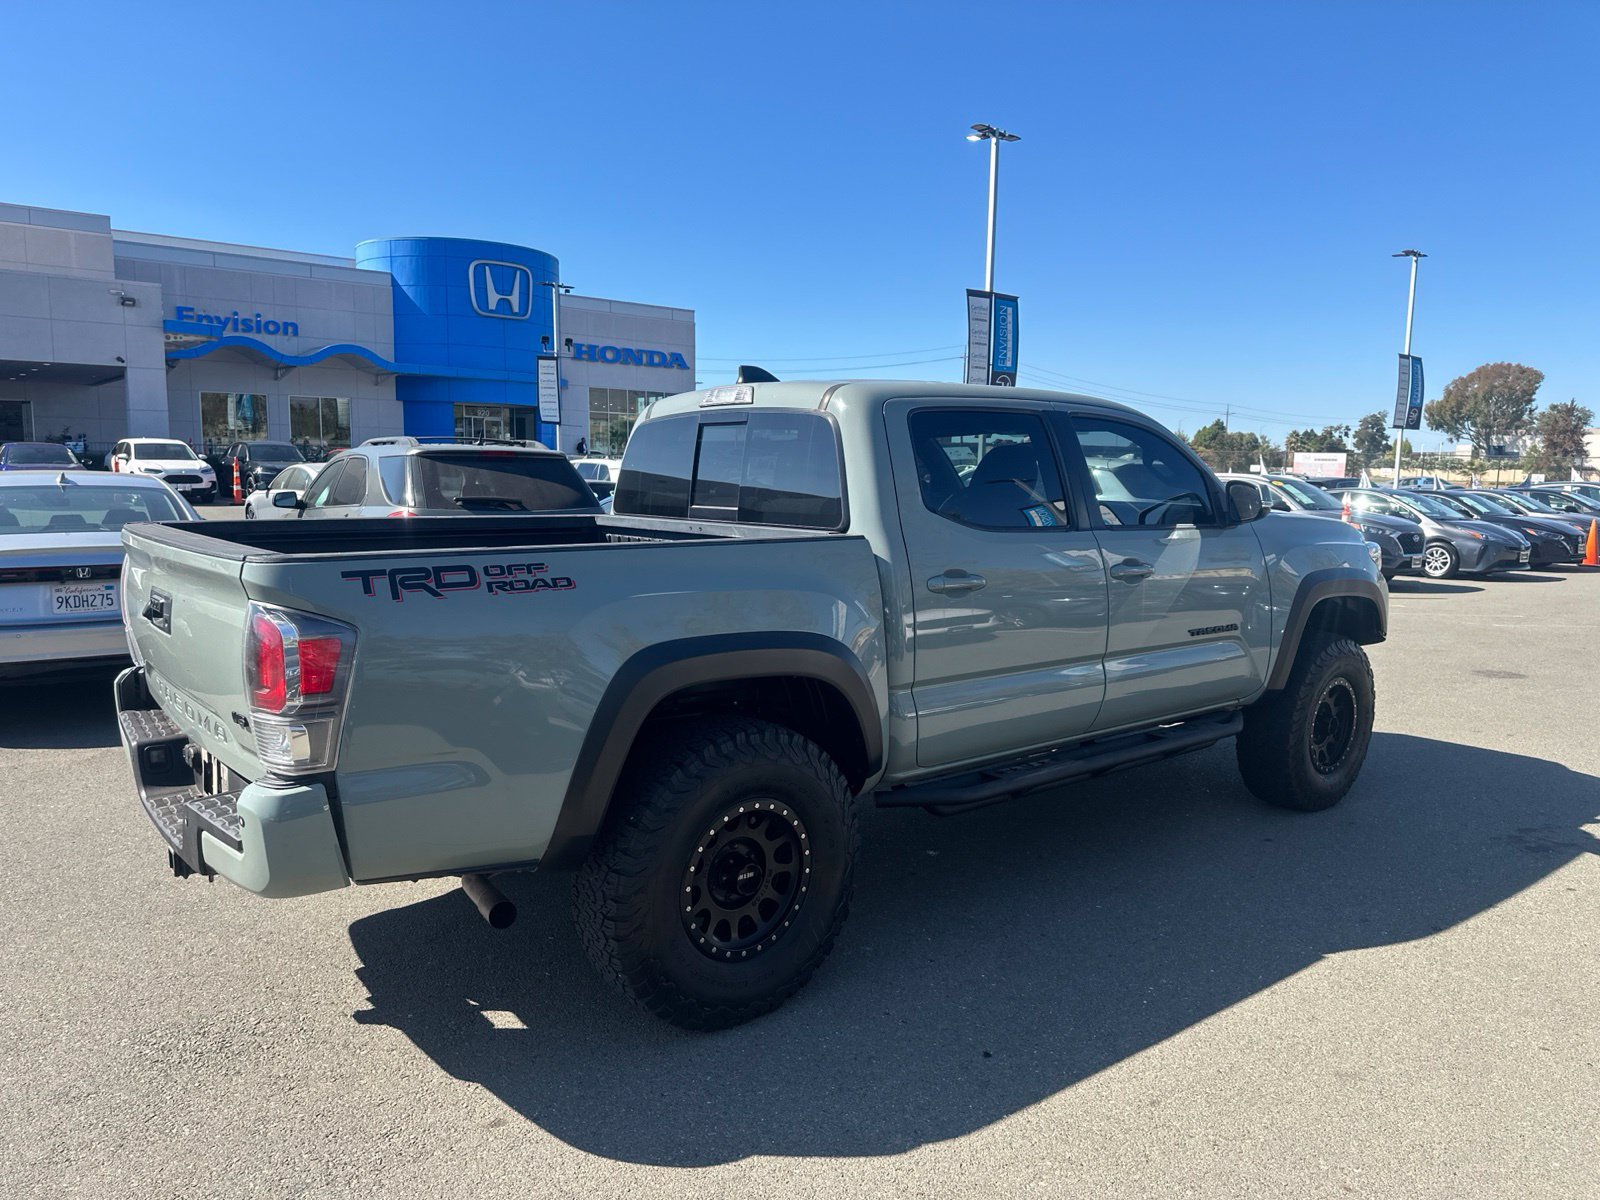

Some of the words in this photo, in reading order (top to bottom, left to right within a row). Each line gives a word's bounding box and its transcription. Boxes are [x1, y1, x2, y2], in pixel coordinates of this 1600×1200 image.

[998, 304, 1007, 367] ENVISION
[572, 342, 690, 370] HONDA
[341, 564, 481, 602] TRD
[483, 563, 549, 579] OFF
[486, 576, 577, 595] ROAD
[56, 593, 114, 610] 9KDH275
